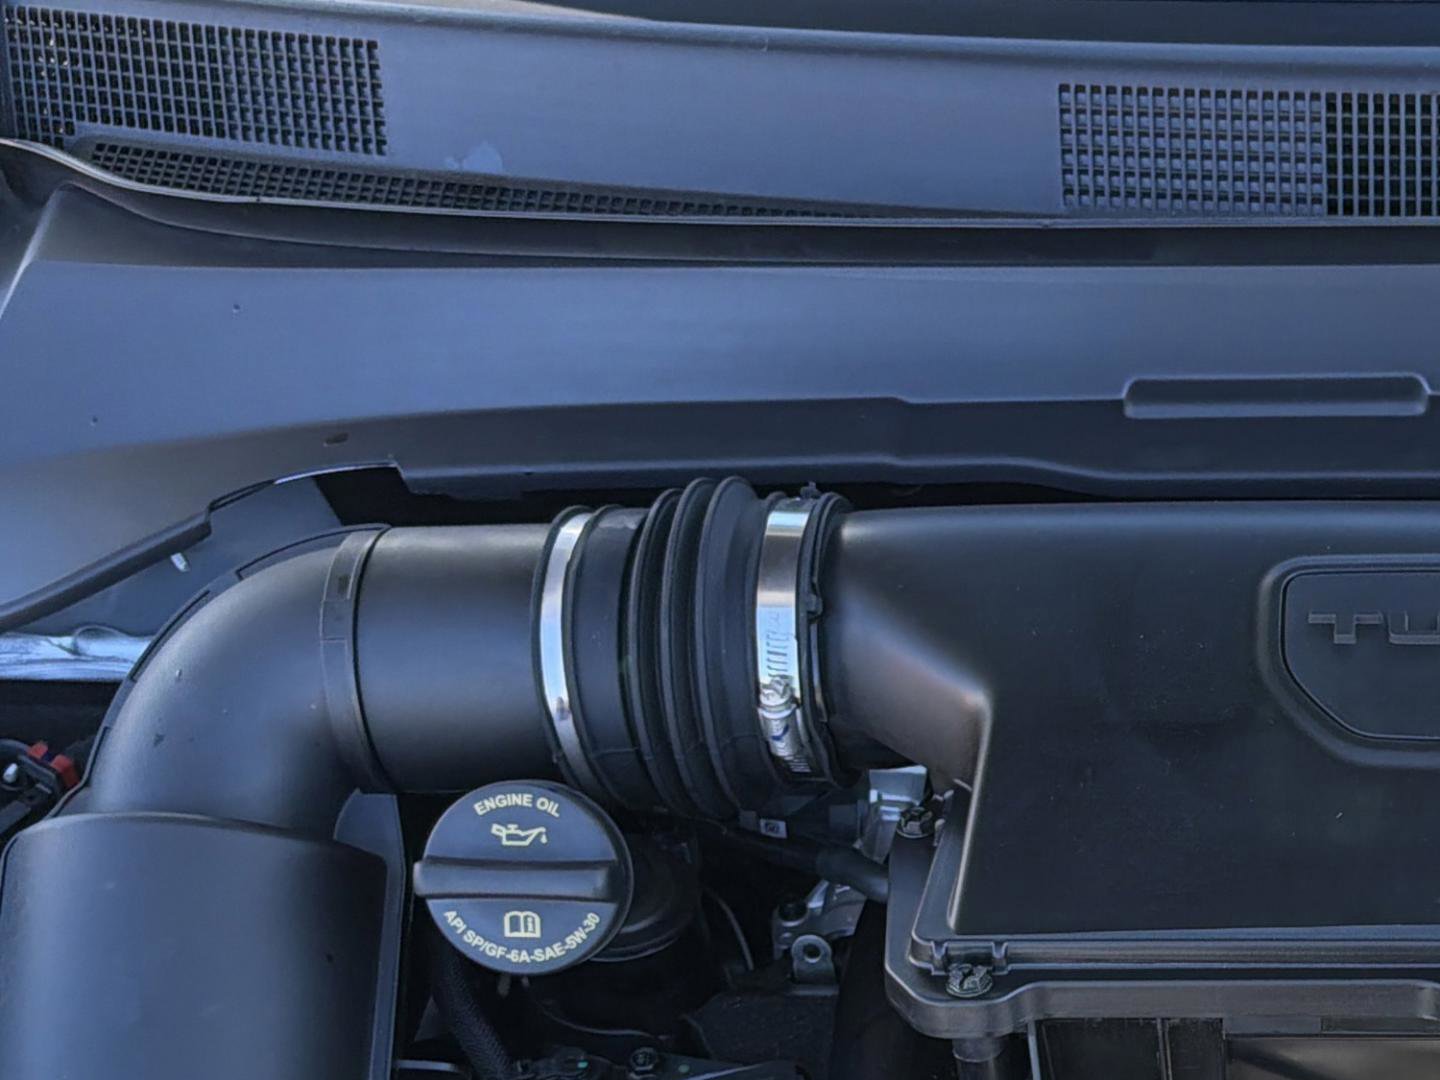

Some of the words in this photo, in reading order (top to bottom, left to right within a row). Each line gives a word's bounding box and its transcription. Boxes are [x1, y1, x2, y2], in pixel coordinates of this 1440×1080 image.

[473, 793, 533, 816] ENGINE
[536, 797, 561, 818] OIL
[444, 909, 465, 934] API
